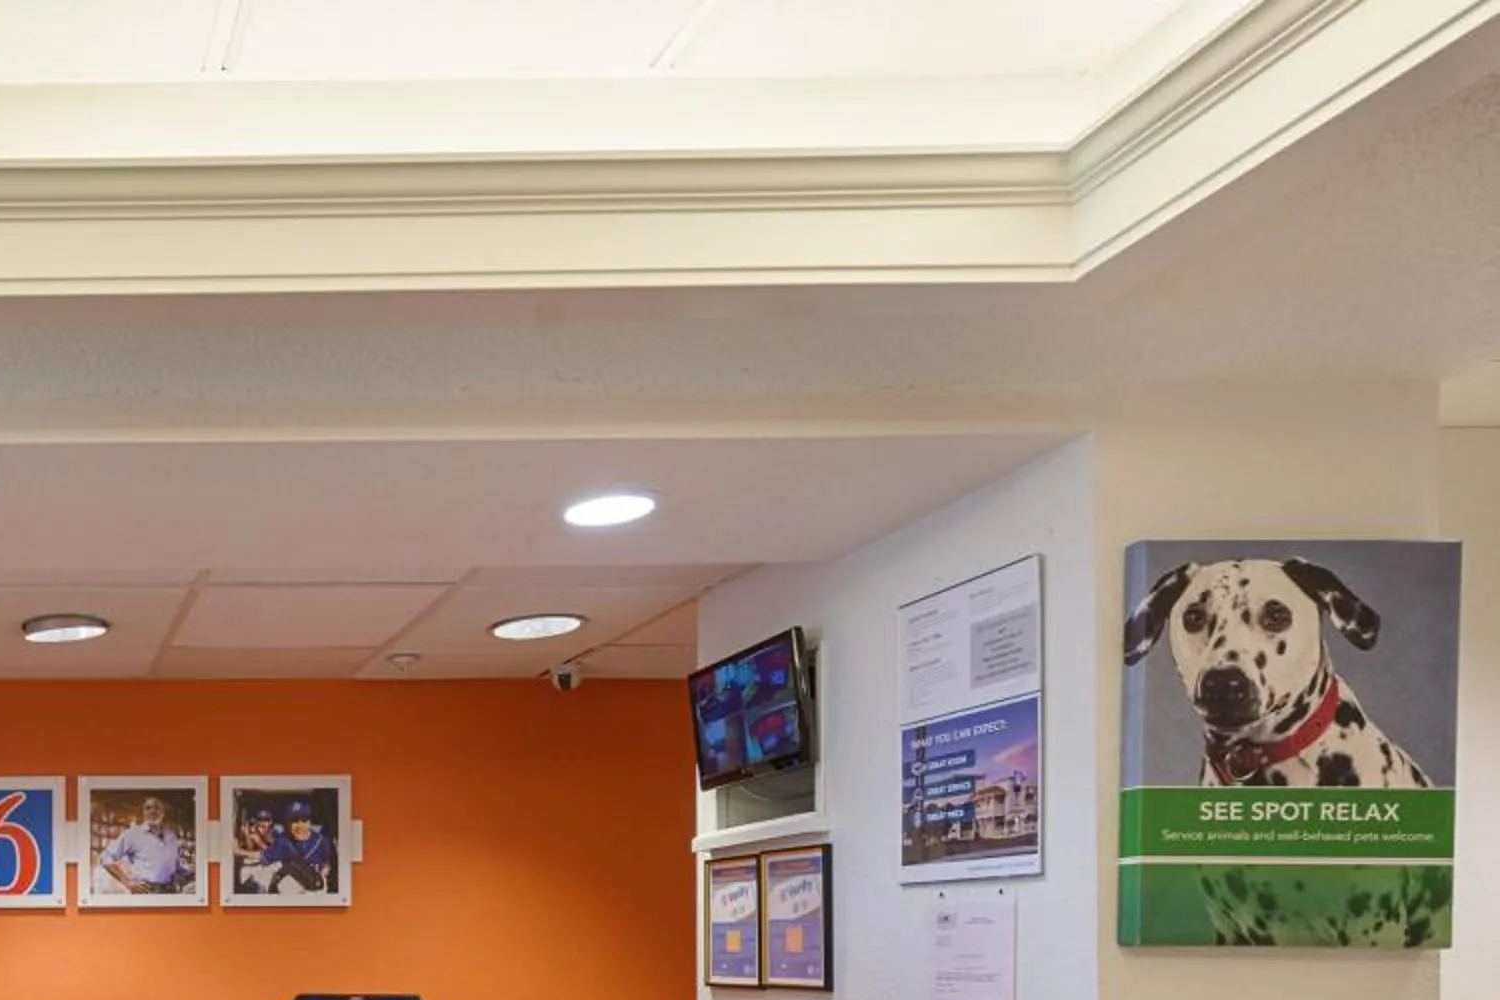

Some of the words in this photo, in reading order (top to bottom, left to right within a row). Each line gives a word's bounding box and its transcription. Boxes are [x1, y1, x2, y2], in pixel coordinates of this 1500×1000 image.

[1199, 801, 1243, 822] SEE
[1251, 801, 1314, 822] SPOT
[1320, 802, 1401, 822] RELAX
[1161, 828, 1202, 842] Service
[1206, 828, 1251, 841] animals
[1252, 829, 1275, 841] and
[1277, 829, 1351, 842] well-behaved
[1353, 829, 1379, 844] pets
